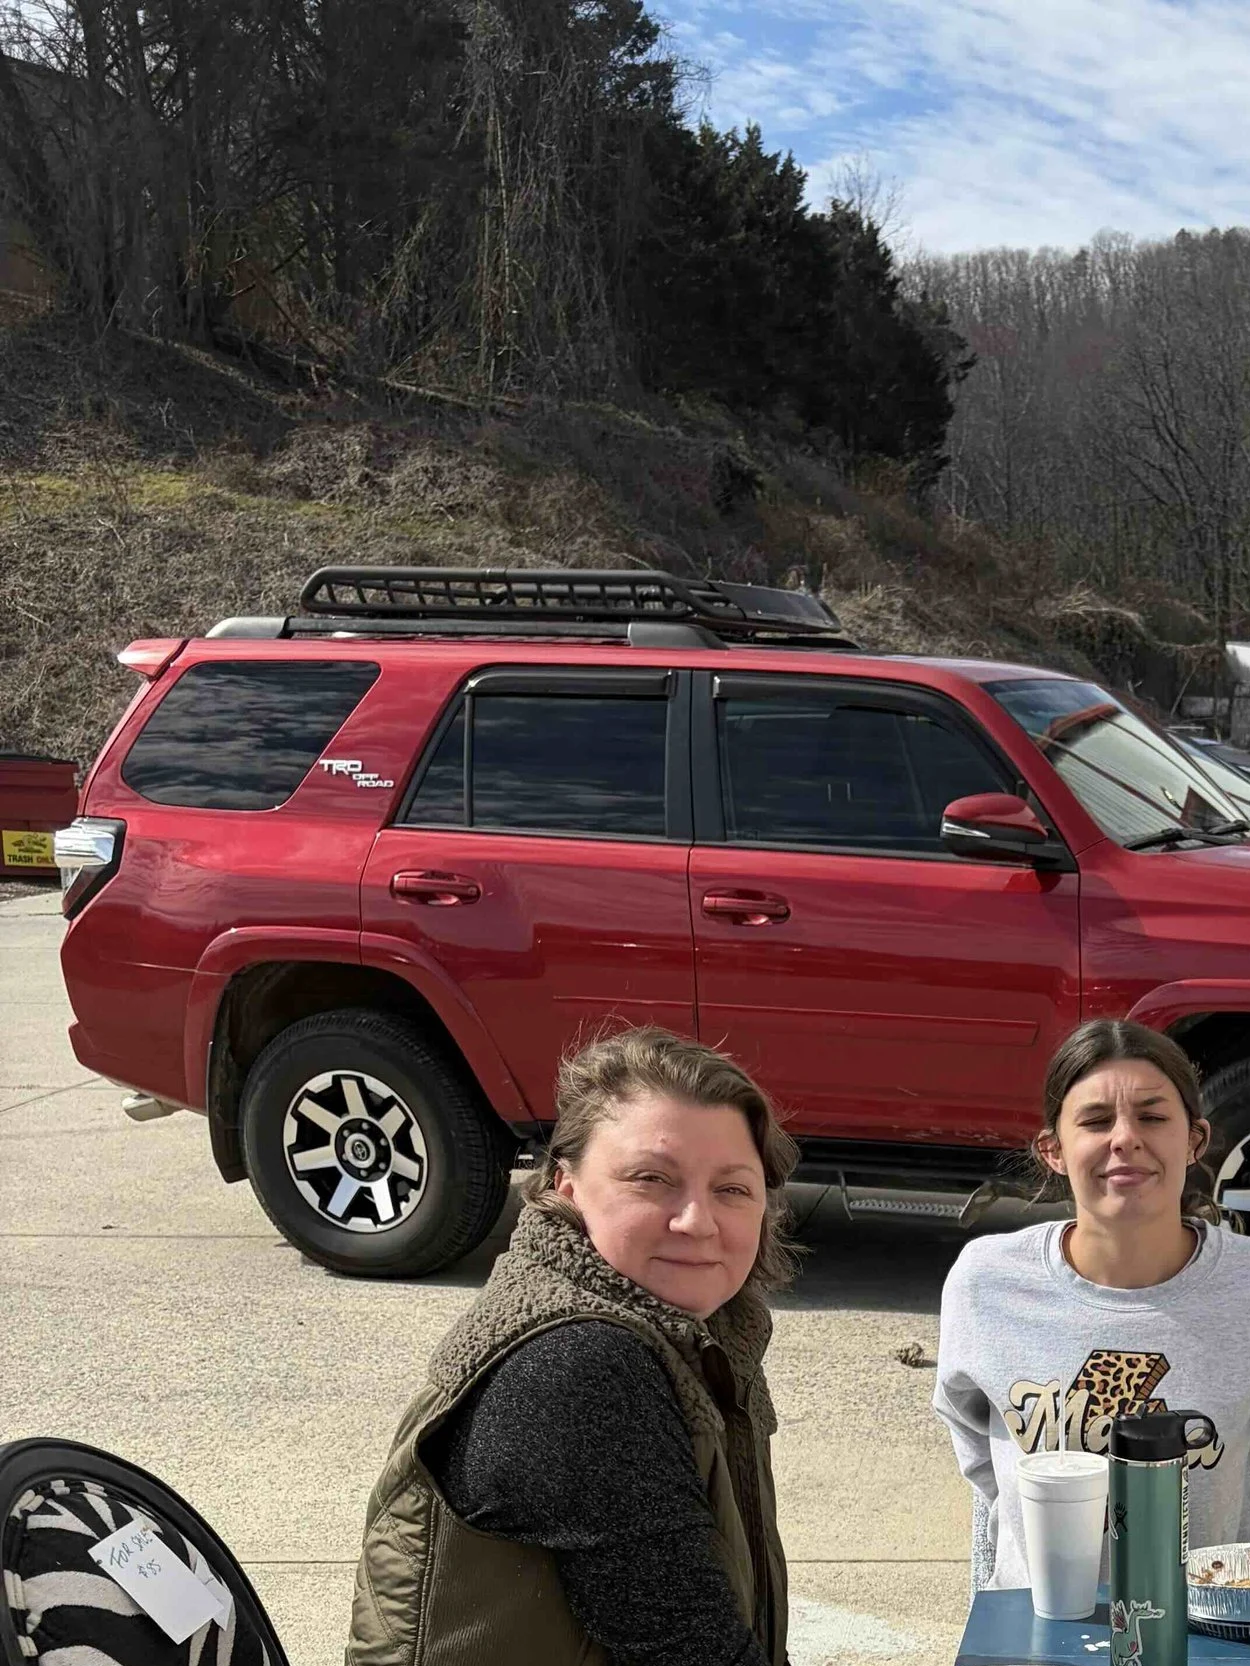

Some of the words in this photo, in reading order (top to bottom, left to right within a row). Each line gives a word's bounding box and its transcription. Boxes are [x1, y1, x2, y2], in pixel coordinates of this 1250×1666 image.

[319, 759, 363, 776] TRD
[352, 773, 380, 781] OFF
[356, 780, 395, 788] ROAD
[7, 854, 34, 864] TRASH
[110, 1542, 135, 1569] FOR
